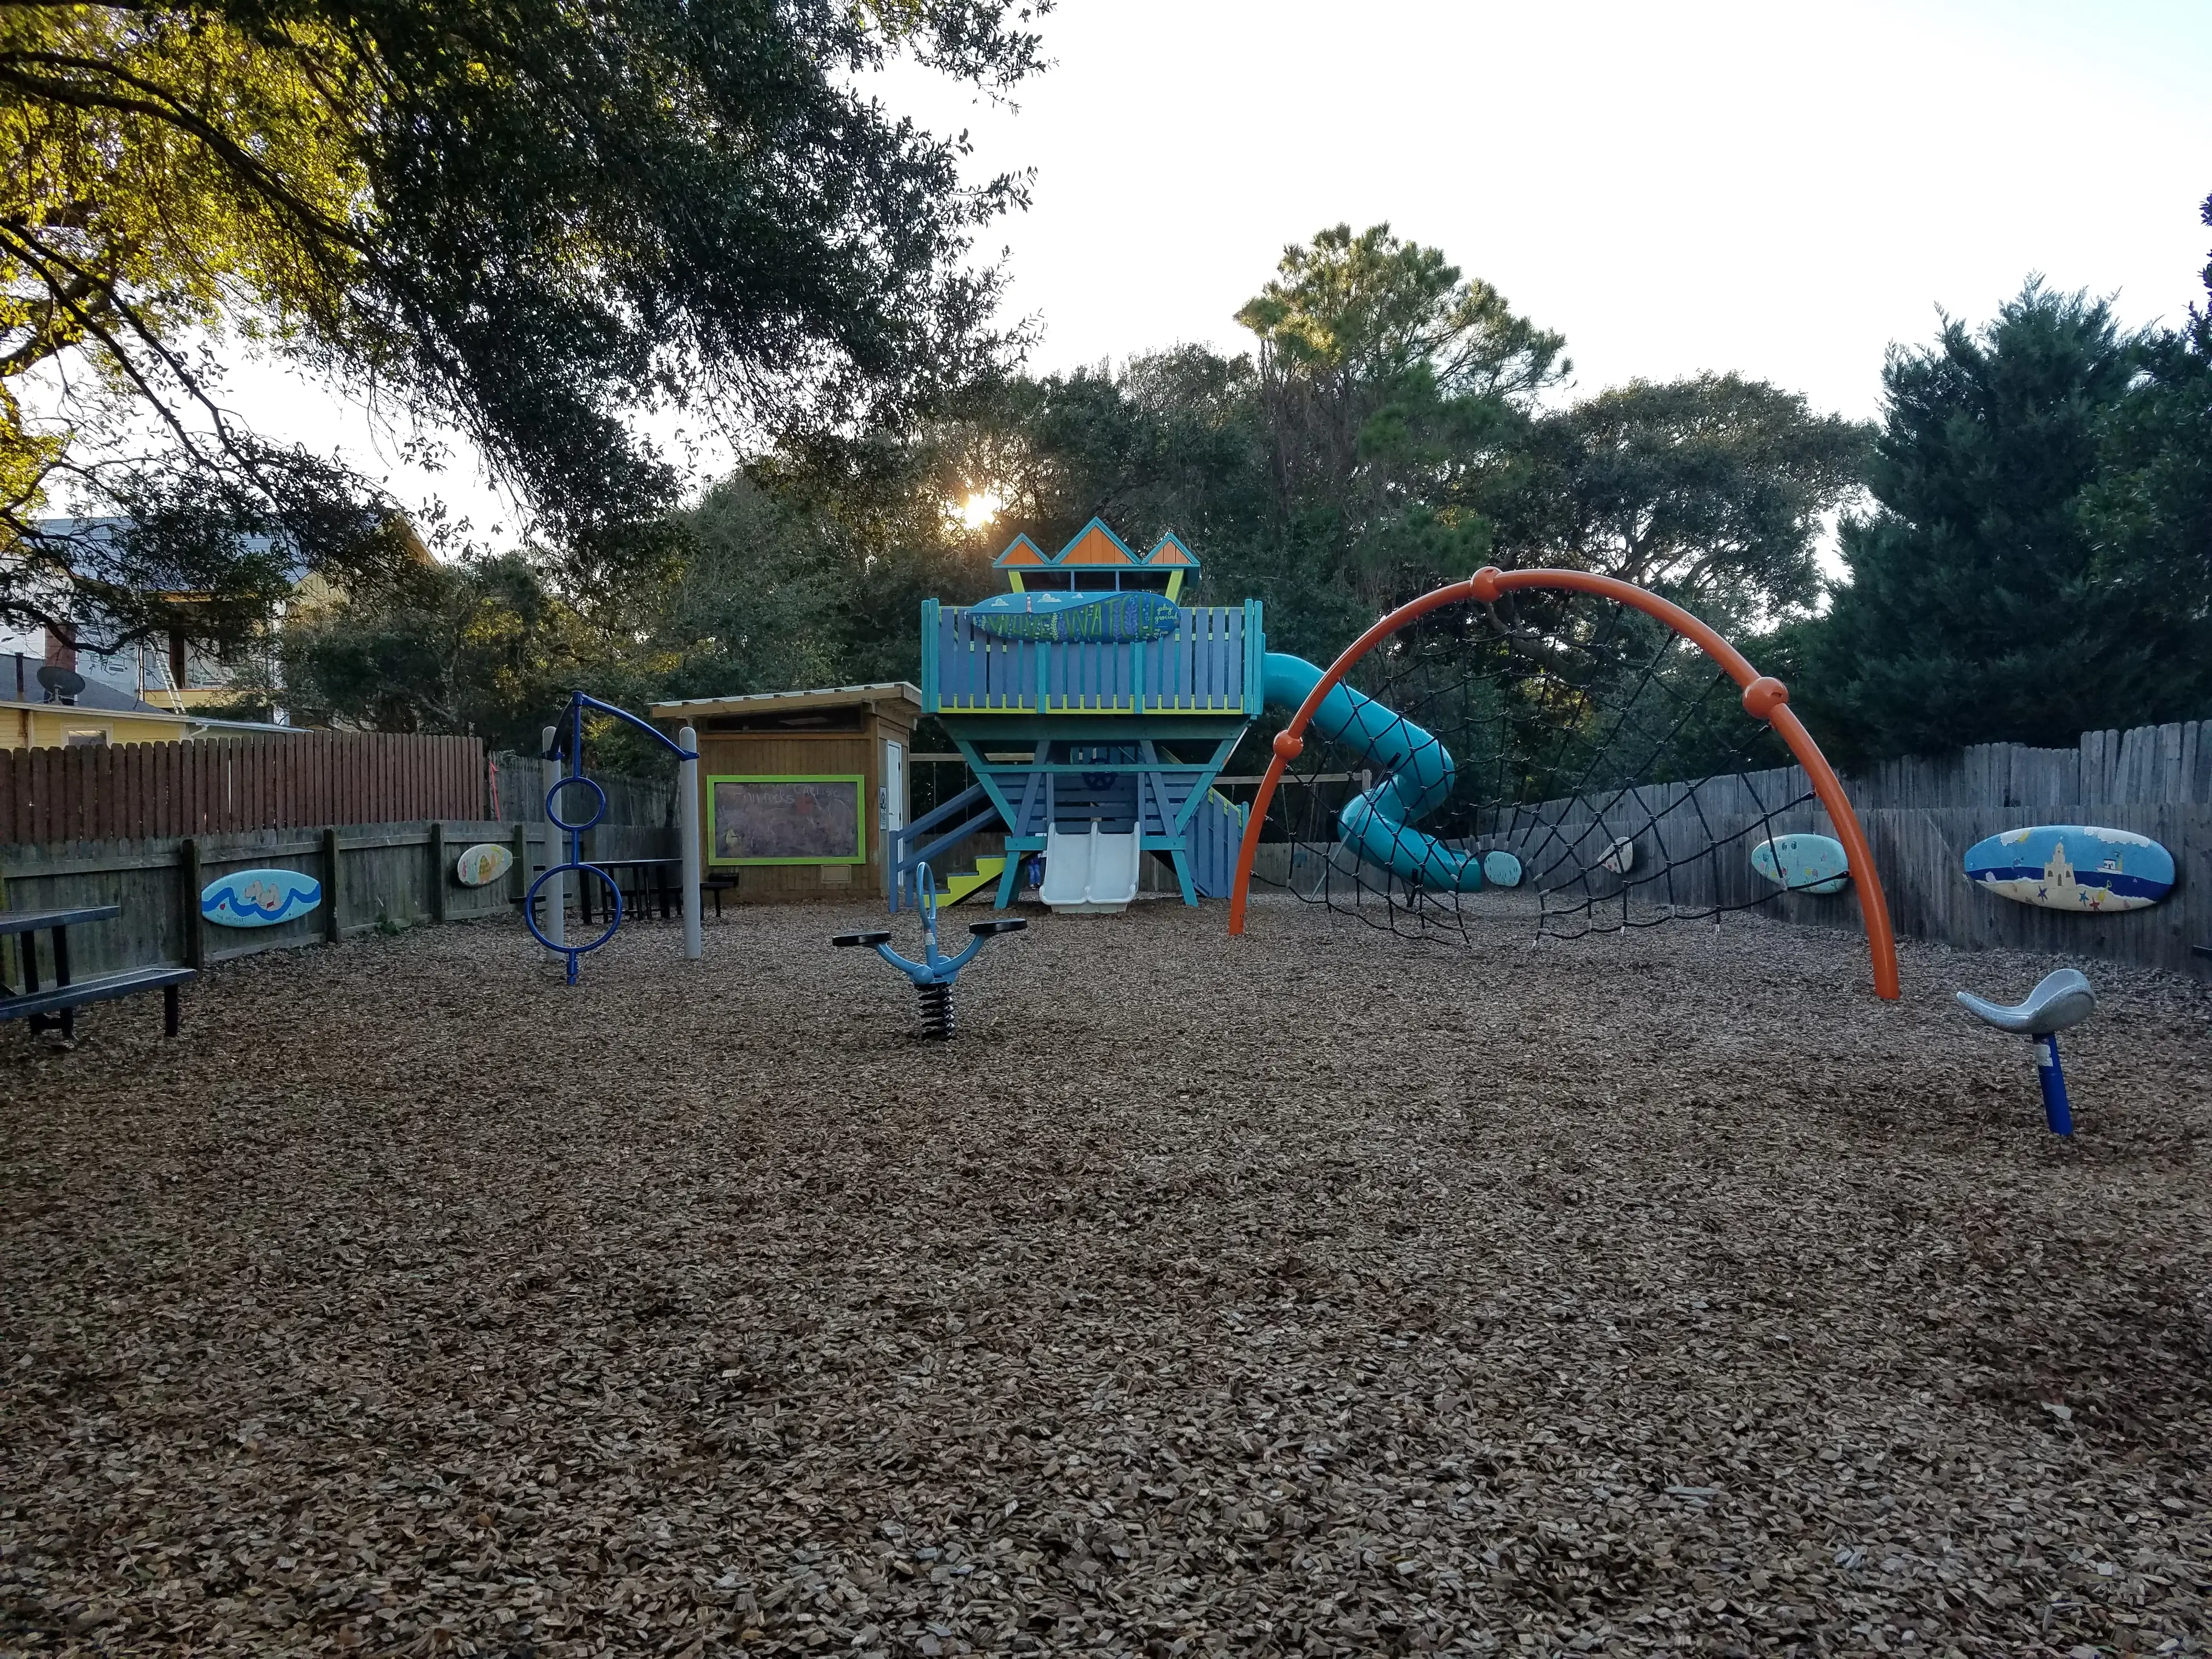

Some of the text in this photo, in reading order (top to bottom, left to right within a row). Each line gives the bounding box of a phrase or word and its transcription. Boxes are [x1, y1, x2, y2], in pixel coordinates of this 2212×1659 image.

[1065, 593, 1154, 639] WATCH
[1156, 603, 1173, 616] play
[1154, 612, 1179, 624] ground
